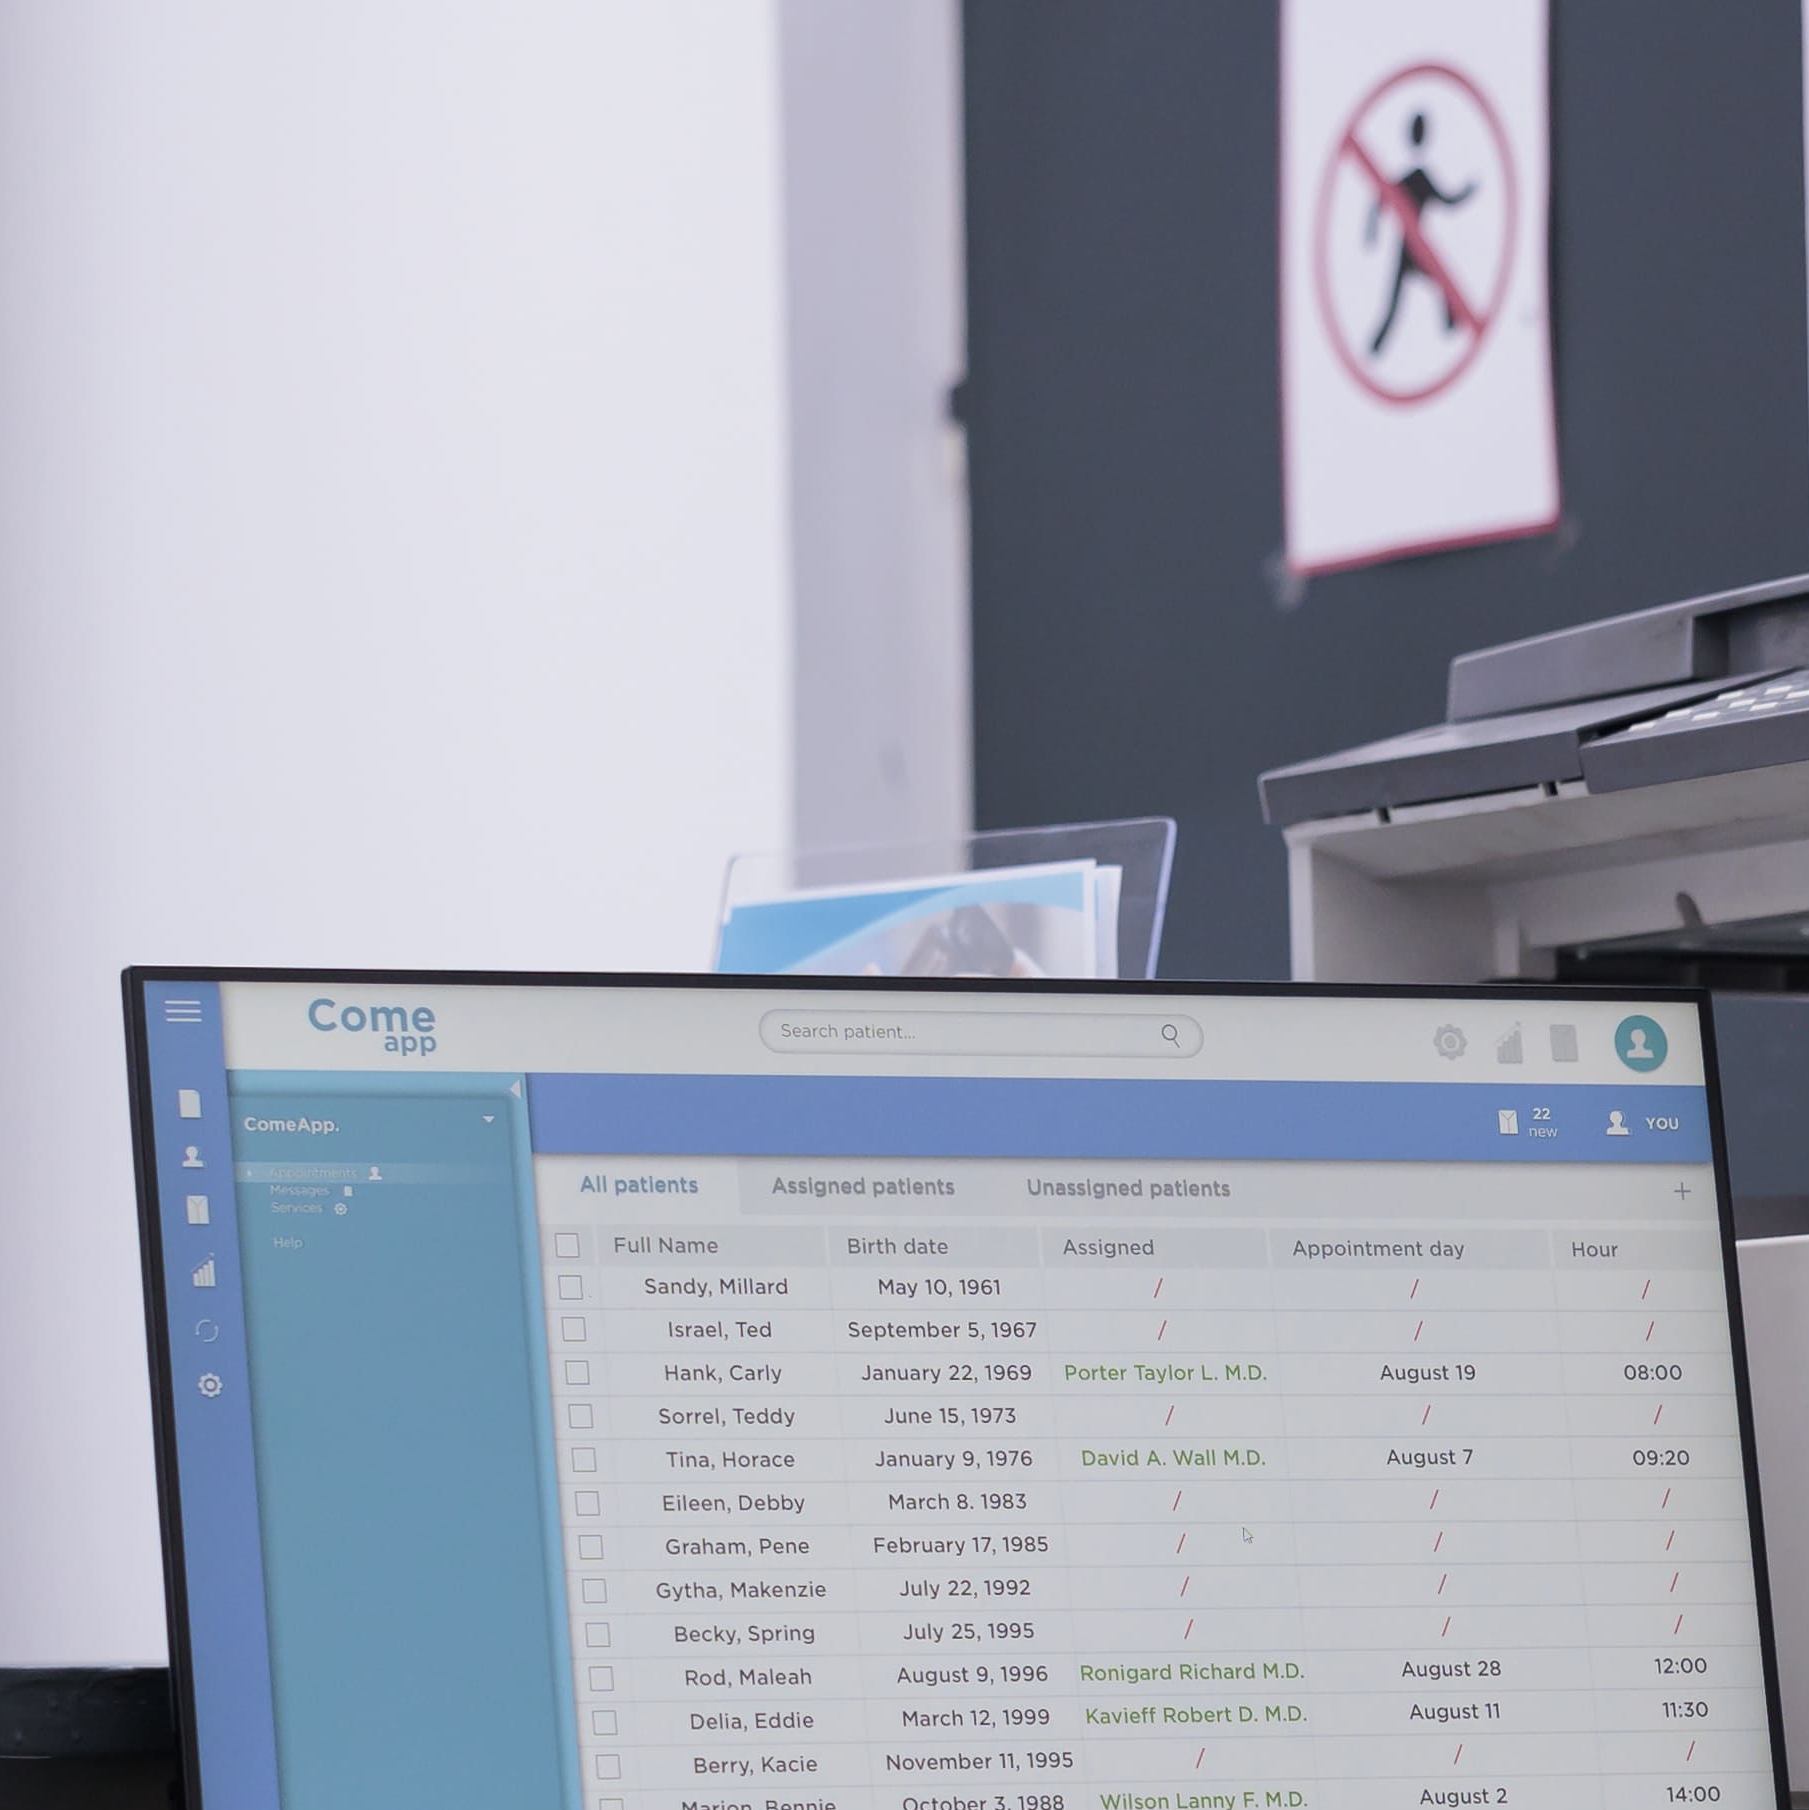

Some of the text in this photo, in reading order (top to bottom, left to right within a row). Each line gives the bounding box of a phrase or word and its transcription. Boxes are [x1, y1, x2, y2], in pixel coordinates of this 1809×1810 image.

[308, 998, 436, 1033] Come
[781, 1023, 916, 1041] Search patient...
[384, 1035, 437, 1057] app
[1532, 1107, 1551, 1122] 22
[1645, 1117, 1679, 1132] YOU
[243, 1116, 340, 1135] ComeApp.
[1528, 1127, 1559, 1140] new
[270, 1184, 331, 1198] Messages
[580, 1175, 699, 1197] All patients
[771, 1176, 955, 1199] Assigned patients
[1027, 1178, 1231, 1200] Unassigned patients
[270, 1202, 323, 1214] Services
[273, 1236, 303, 1249] Help
[613, 1236, 719, 1254] Full Name
[847, 1237, 949, 1255] Birth date
[1063, 1238, 1155, 1259] Assigned
[1292, 1239, 1465, 1260] Appointment day
[1572, 1241, 1618, 1258] Hour
[644, 1277, 788, 1298] Sandy, Millard
[878, 1278, 1001, 1299] May 10, 1961
[668, 1320, 772, 1340] Israel, Ted
[848, 1320, 1037, 1342] September 5, 1967
[664, 1364, 782, 1385] Hank, Carly
[861, 1364, 1032, 1385] January 22, 1969
[1064, 1364, 1267, 1384] Porter Taylor L. M.D.
[1380, 1364, 1476, 1384] August 19
[1623, 1364, 1683, 1381] 08:00
[658, 1407, 796, 1428] Sorrel, Teddy
[884, 1407, 1016, 1426] June 15, 1973
[665, 1451, 795, 1471] Tina, Horace
[875, 1450, 1033, 1471] January 9, 1976
[1081, 1448, 1266, 1467] David A. Wall M.D.
[1386, 1448, 1474, 1469] August 7
[1632, 1449, 1690, 1466] 09:20
[662, 1493, 805, 1515] Eileen, Debby
[888, 1493, 950, 1510] March
[980, 1493, 1027, 1510] 1983
[665, 1537, 810, 1558] Graham, Pene
[873, 1535, 1049, 1557] February 17, 1985
[656, 1580, 827, 1602] Gytha, Makenzie
[899, 1579, 1031, 1600] July 22, 1992
[674, 1624, 815, 1646] Becky, Spring
[903, 1622, 1035, 1644] July 25, 1995
[897, 1665, 1048, 1687] August 9, 1996
[1080, 1662, 1305, 1685] Ronigard Richard M.D.
[1401, 1660, 1502, 1681] August 28
[1654, 1657, 1708, 1674] 12:00
[685, 1667, 812, 1689] Rod, Maleah
[902, 1708, 1050, 1729] March 12, 1999
[1085, 1705, 1308, 1725] Kavieff Robert D. M.D.
[1409, 1702, 1500, 1724] August 11
[1662, 1701, 1709, 1718] 11:30
[690, 1711, 814, 1732] Delia, Eddie
[693, 1755, 818, 1777] Berry, Kacie
[886, 1751, 1074, 1772] November 11, 1995
[1099, 1792, 1170, 1810] Wilson
[1243, 1791, 1259, 1809] F.
[1265, 1790, 1308, 1808] M.D.
[1419, 1787, 1508, 1808] August 2
[1666, 1785, 1721, 1803] 14:00
